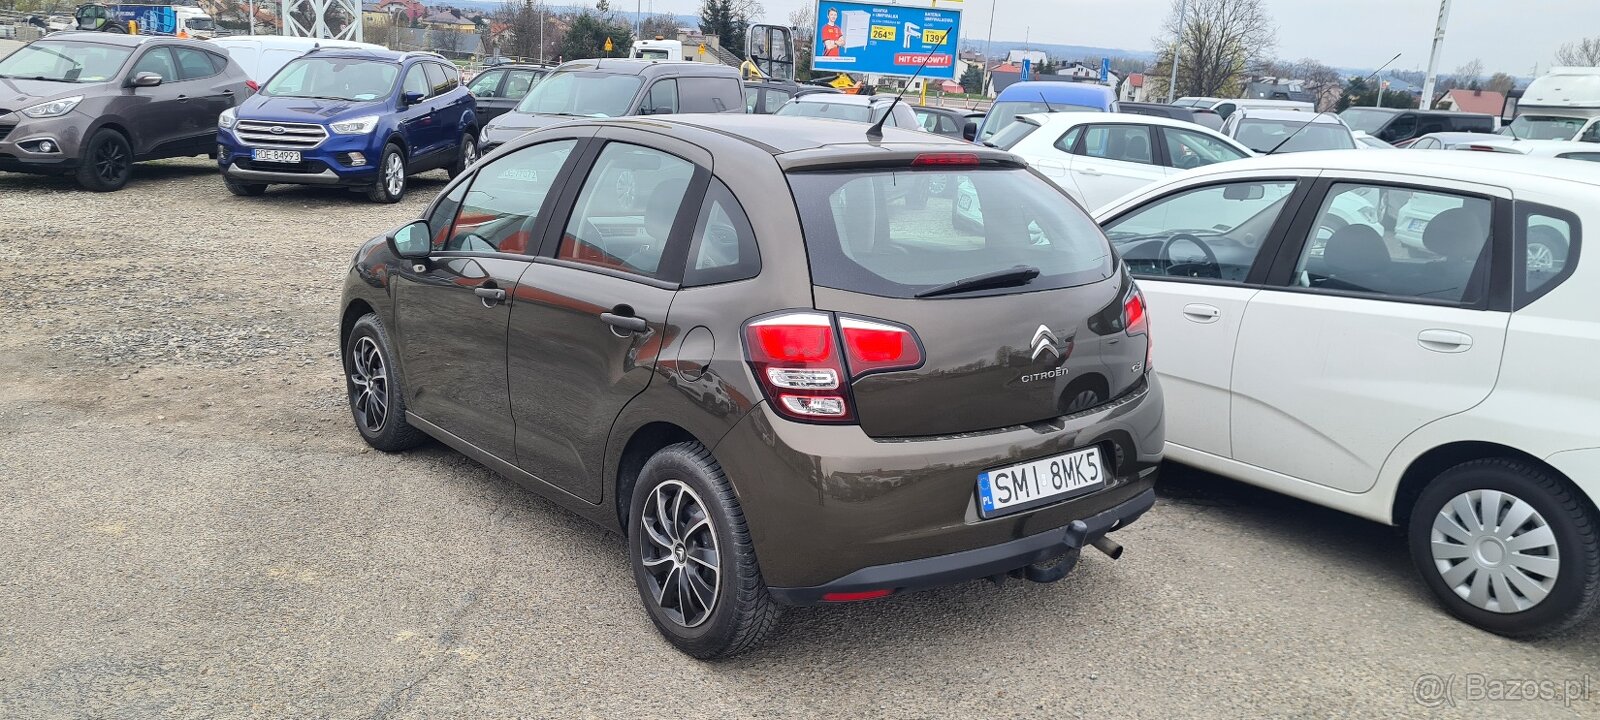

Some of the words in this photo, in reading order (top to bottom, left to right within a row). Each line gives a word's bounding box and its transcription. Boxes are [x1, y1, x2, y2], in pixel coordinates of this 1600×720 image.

[873, 30, 888, 39] 264
[925, 34, 940, 43] 139
[912, 55, 949, 64] CENOWY!
[255, 149, 272, 160] RDE
[274, 150, 300, 161] 84993
[995, 465, 1041, 504] SMI
[1049, 451, 1099, 490] 8MK5
[982, 496, 993, 506] PL
